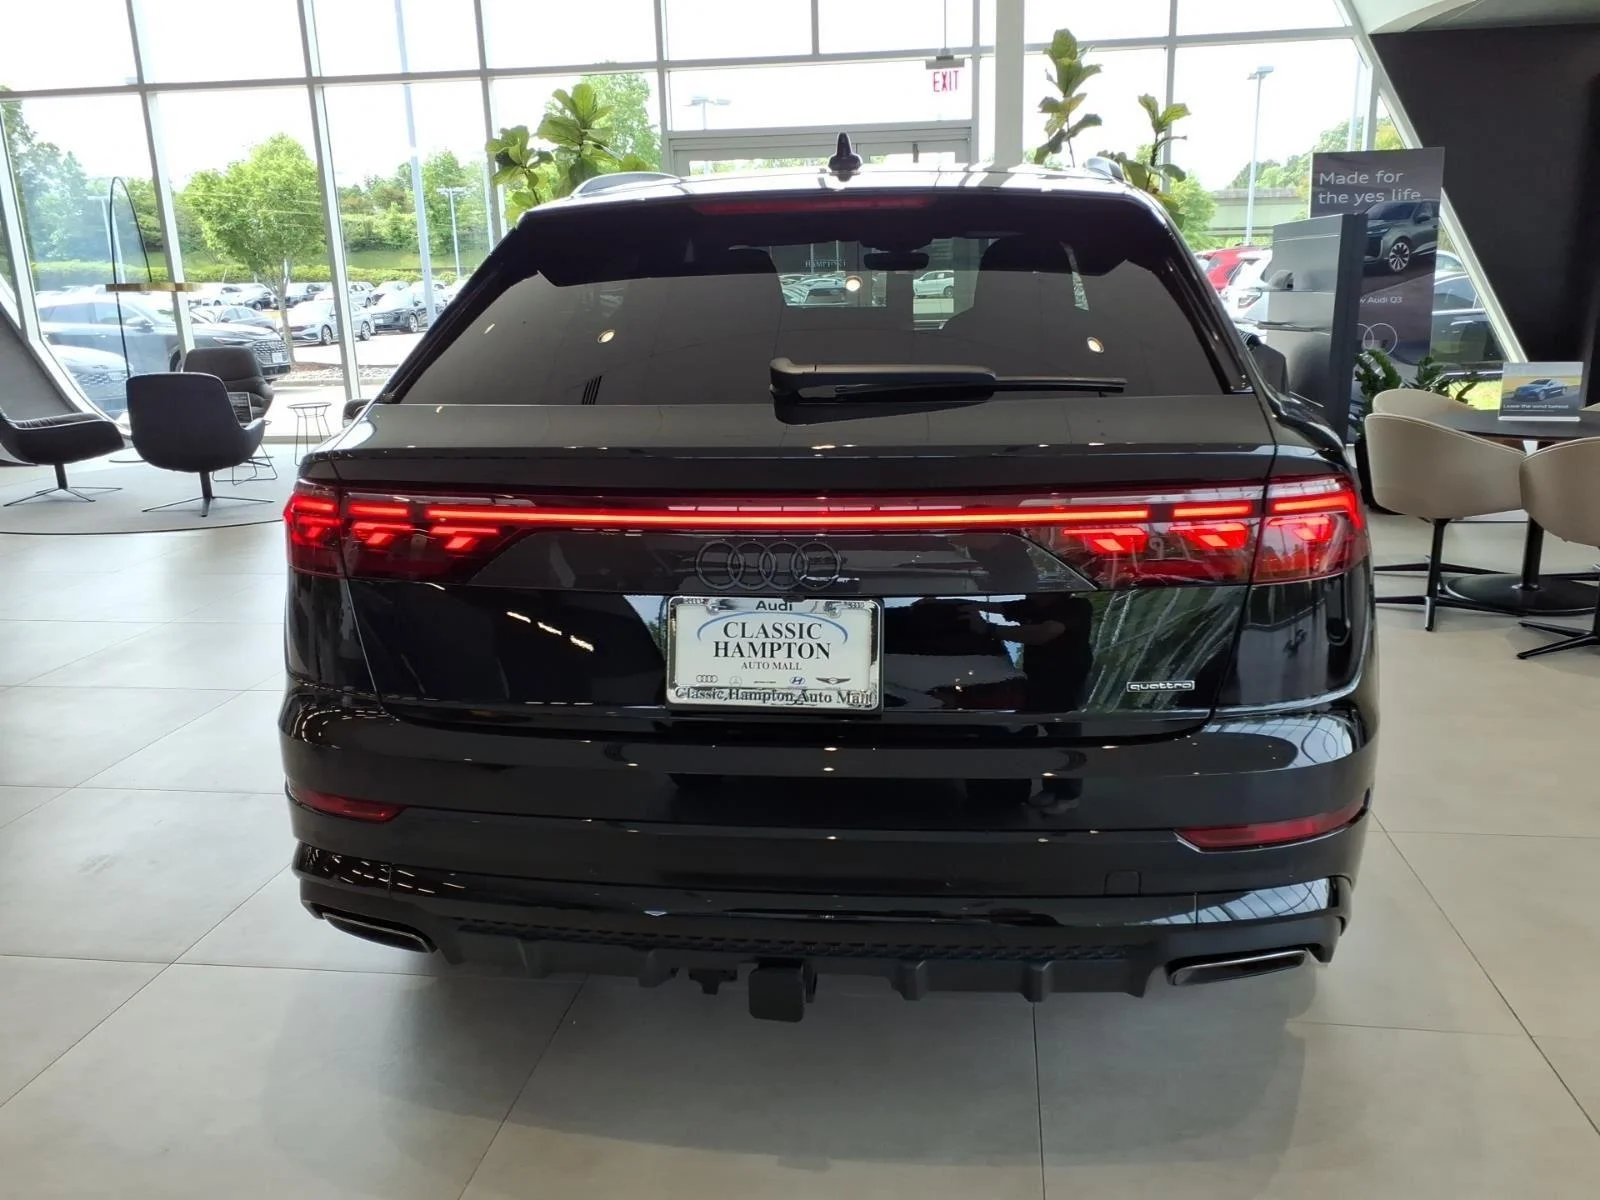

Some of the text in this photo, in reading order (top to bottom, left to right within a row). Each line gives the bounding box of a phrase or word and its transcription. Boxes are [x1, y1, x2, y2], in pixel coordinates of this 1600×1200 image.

[933, 70, 959, 92] EXIT
[1319, 170, 1404, 185] Made for
[1318, 192, 1349, 204] the
[1353, 192, 1385, 206] yes
[1368, 296, 1388, 304] Audi
[1390, 296, 1403, 304] Q3
[755, 600, 793, 611] Audi
[723, 621, 822, 640] CLASSIC
[713, 641, 831, 660] HAMPTON
[741, 661, 802, 671] AUTO MALL
[1129, 682, 1192, 691] quattro
[800, 690, 832, 703] Auto
